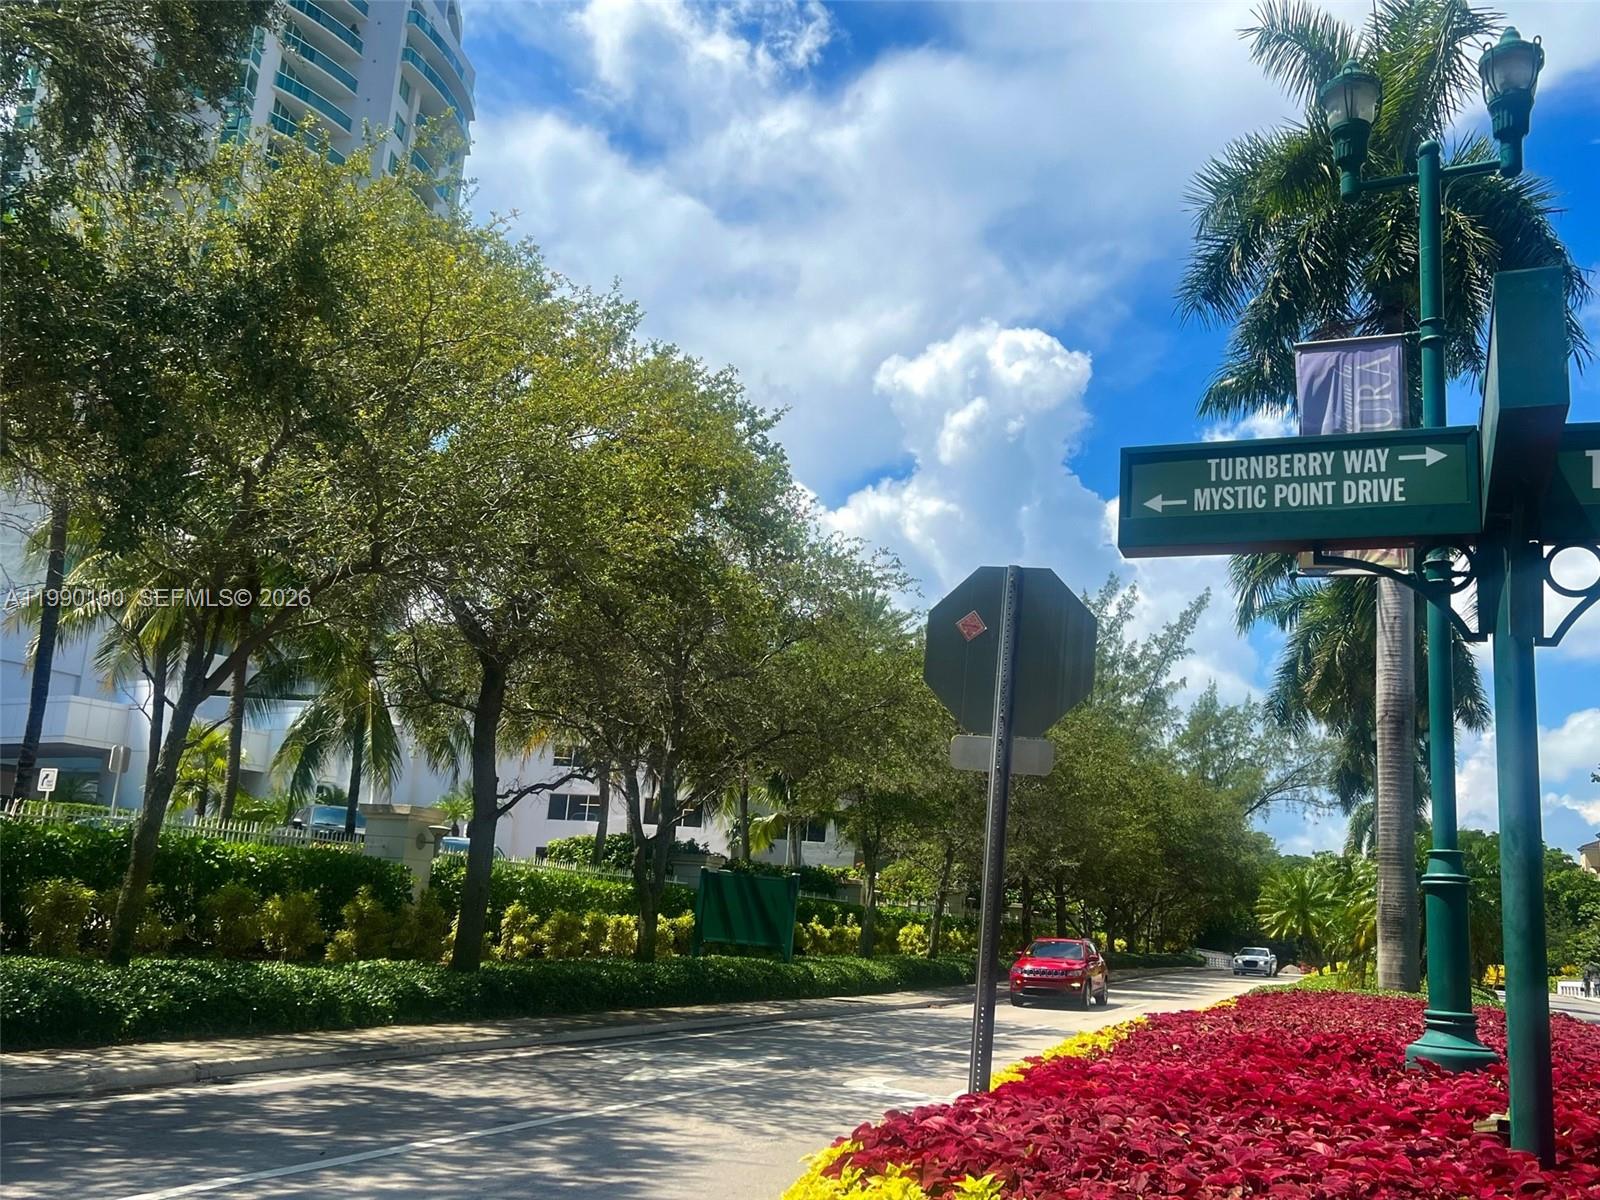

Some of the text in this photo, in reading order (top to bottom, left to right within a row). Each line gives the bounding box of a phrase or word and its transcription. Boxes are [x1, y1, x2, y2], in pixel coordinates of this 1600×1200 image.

[1356, 353, 1393, 431] URA
[1207, 448, 1390, 482] TURNBERRY WAY
[1194, 477, 1406, 512] MYSTIC POINT DRIVE
